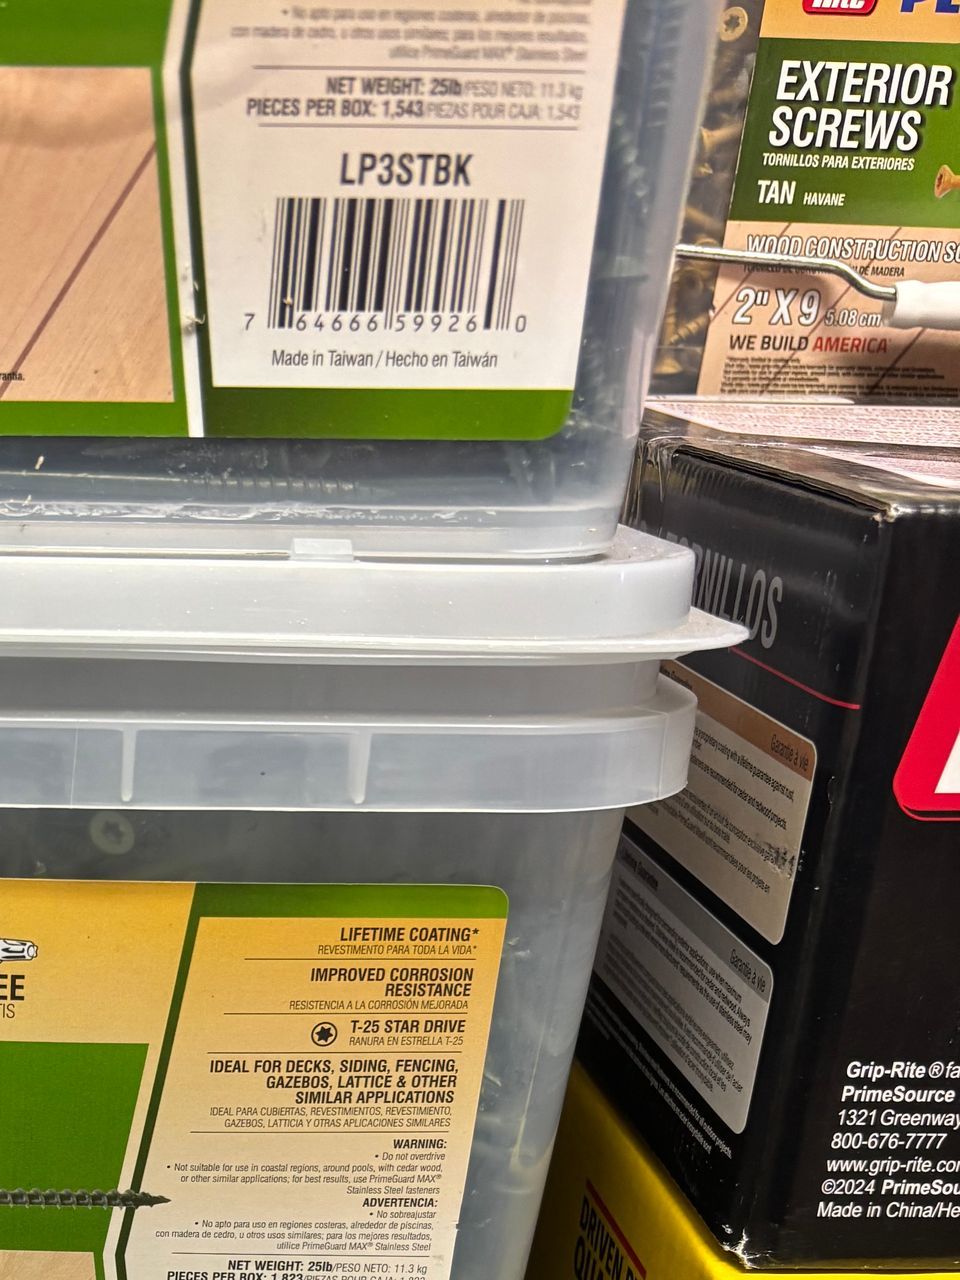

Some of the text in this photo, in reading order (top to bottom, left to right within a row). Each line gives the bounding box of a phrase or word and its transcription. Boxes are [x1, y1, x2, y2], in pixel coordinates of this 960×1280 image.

[776, 60, 952, 106] EXTERIOR
[769, 106, 923, 151] SCREWS
[339, 153, 474, 186] LP3STBK
[762, 153, 914, 171] TORNILLOS PARA EXTERIORES
[757, 179, 845, 206] TAN HAVANE
[732, 289, 881, 327] 2" X 9 5.08 cm
[340, 928, 405, 941] LIFETIME
[318, 945, 384, 954] REVESTIMENTO
[387, 945, 409, 954] PARA
[411, 945, 435, 954] TODA
[437, 945, 449, 954] LA
[310, 968, 473, 982] IMPROVED CORROSION
[385, 983, 471, 997] RESISTANCE
[351, 1020, 466, 1033] T-25 STAR DRIVE
[210, 1060, 459, 1075] IDEAL FOR DECKS, SIDING, FENCING,
[266, 1075, 457, 1091] GAZEBOS, LATTICE & OTHER
[295, 1090, 454, 1104] SIMILAR APPLICATIONS
[841, 1086, 955, 1103] PrimeSource
[393, 1139, 447, 1149] WARNING:
[831, 1133, 946, 1149] 800-676-7777
[579, 1195, 624, 1278] DRIVEN
[228, 1260, 252, 1271] NET
[255, 1261, 304, 1272] WEIGHT:
[362, 1263, 391, 1273] NETO:
[395, 1263, 414, 1274] 11.3
[417, 1263, 427, 1275] kg
